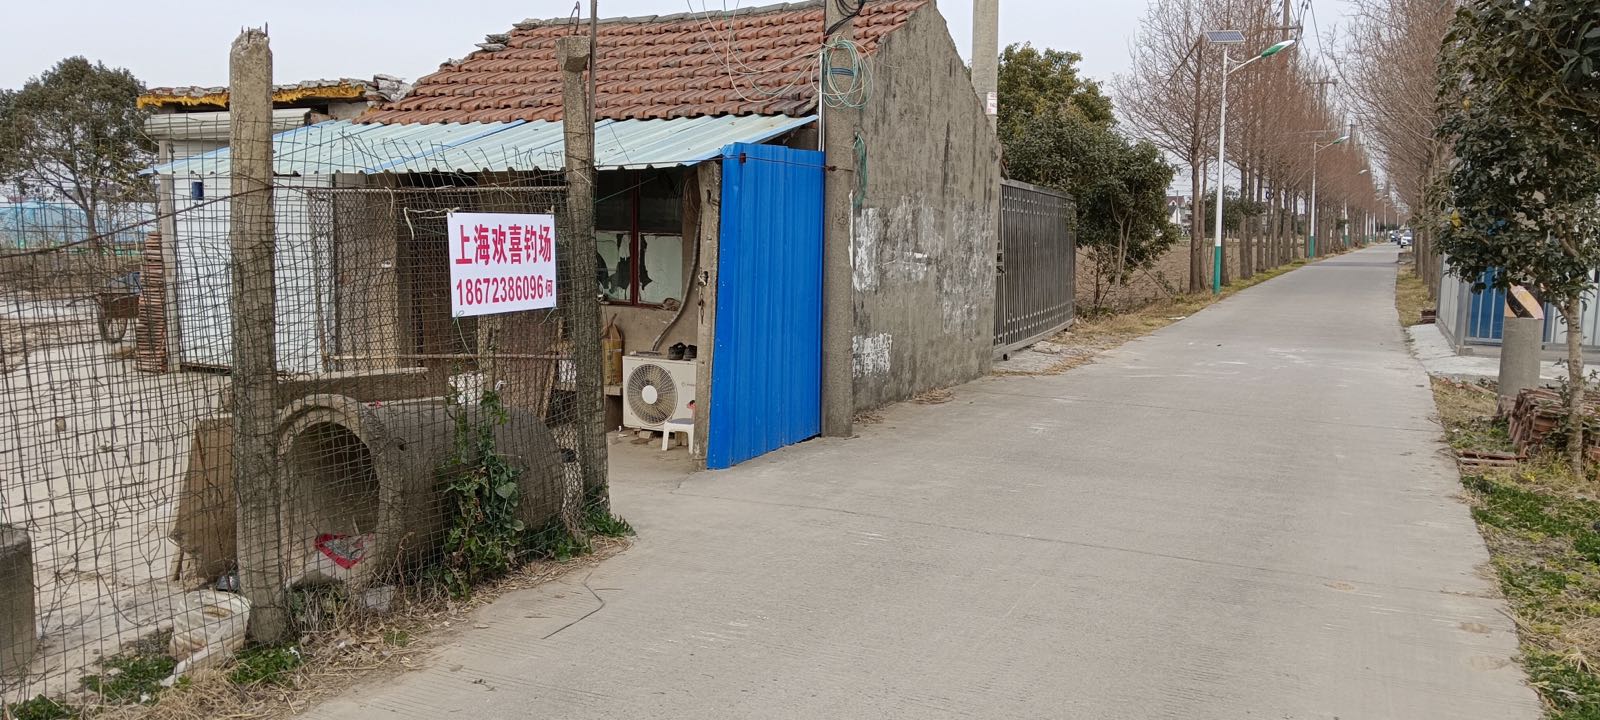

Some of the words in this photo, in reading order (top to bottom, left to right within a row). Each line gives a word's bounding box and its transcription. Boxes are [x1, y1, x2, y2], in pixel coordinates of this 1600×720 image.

[455, 224, 552, 265] 上海欢喜钓场
[456, 275, 544, 306] 18672386096
[545, 279, 553, 297] 何
